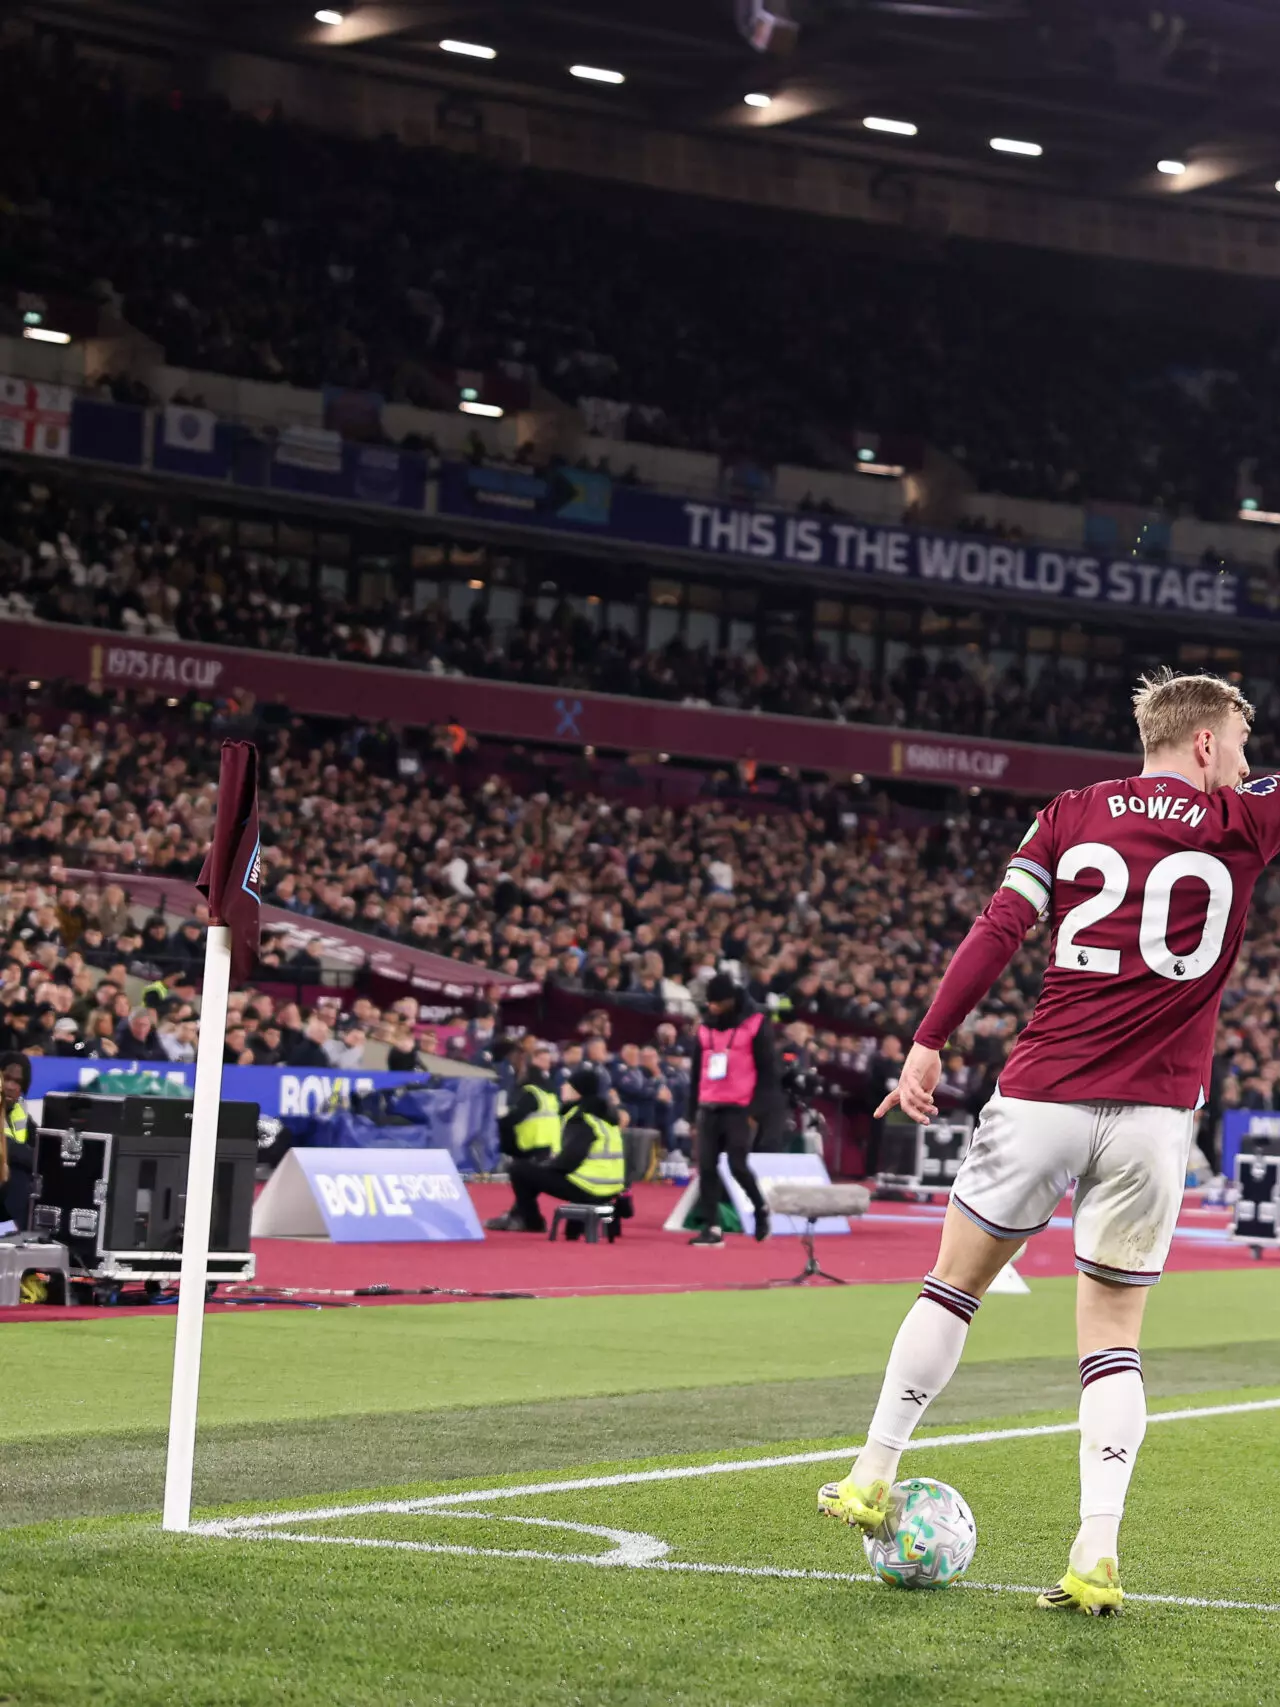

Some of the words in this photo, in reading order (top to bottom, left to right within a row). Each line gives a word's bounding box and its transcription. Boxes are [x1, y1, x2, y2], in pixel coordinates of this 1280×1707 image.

[684, 503, 778, 557] THIS
[784, 518, 822, 562] IS
[830, 524, 909, 574] THE
[918, 537, 1101, 600] WORLD'S
[1107, 561, 1238, 615] STAGE
[107, 647, 150, 679] 1975
[152, 652, 176, 681] FA
[180, 656, 224, 689] CUP
[971, 749, 1010, 779] CUP
[1106, 795, 1207, 828] BOWEN
[1055, 842, 1233, 981] 20
